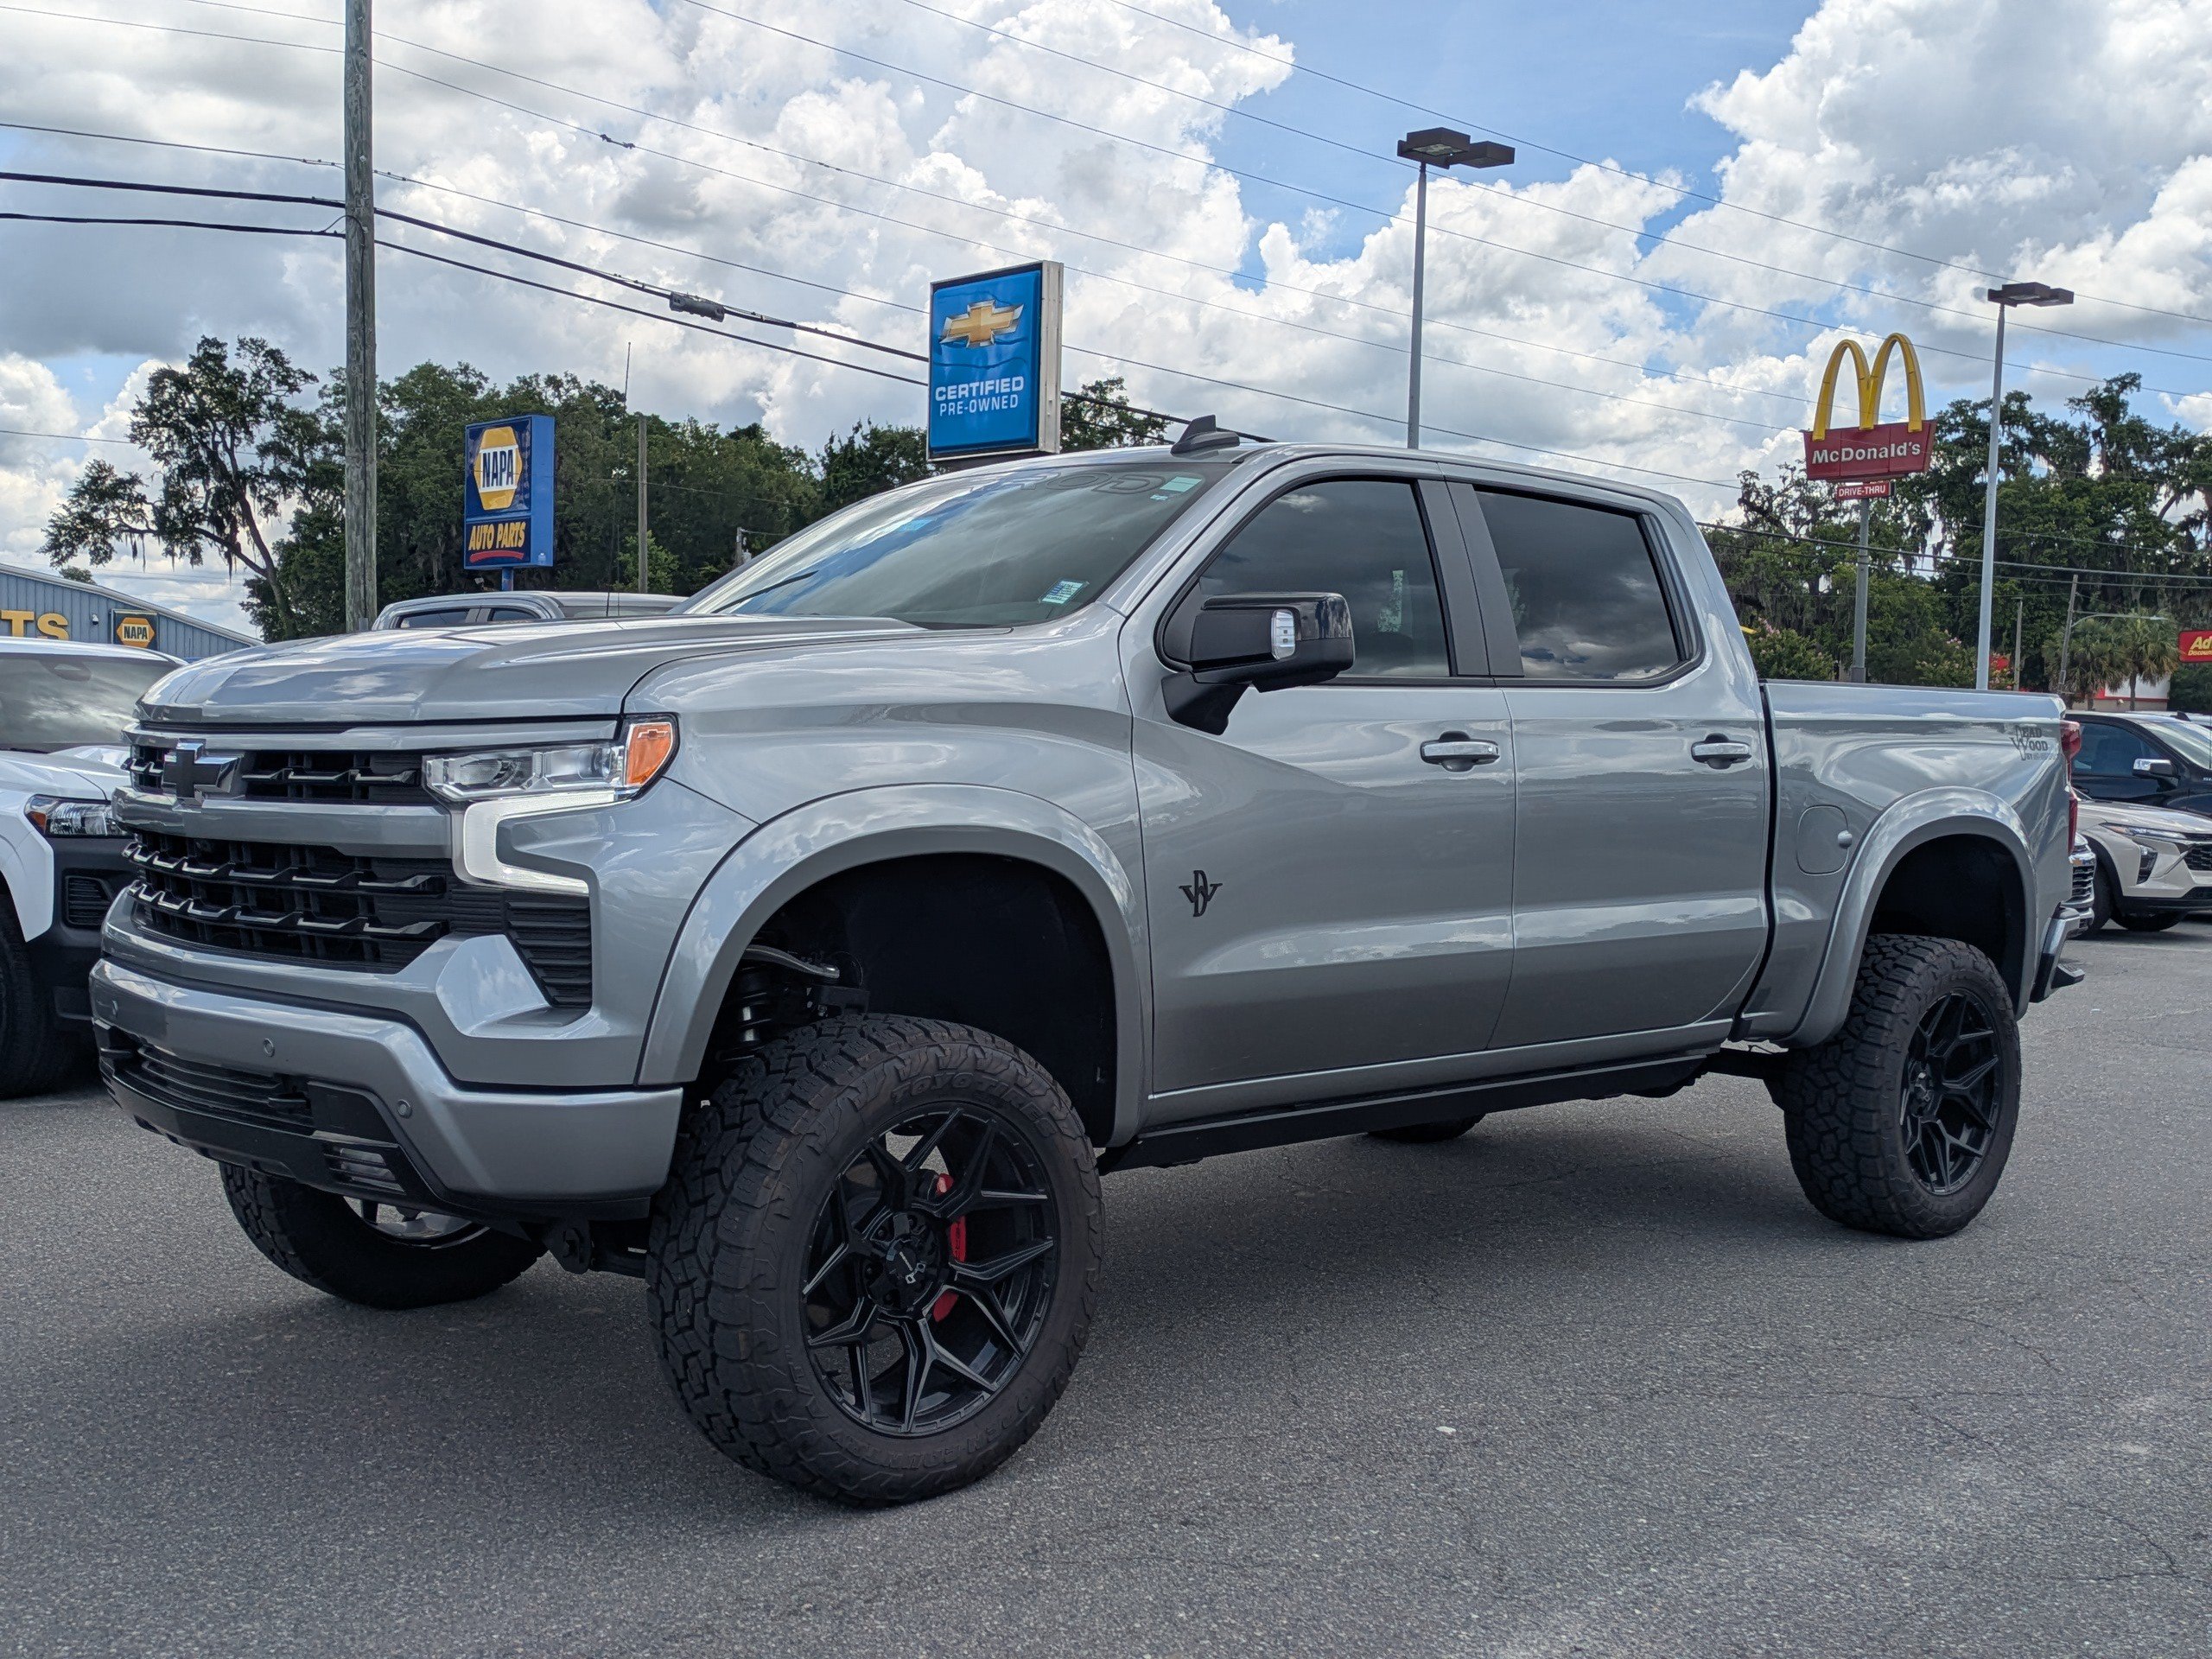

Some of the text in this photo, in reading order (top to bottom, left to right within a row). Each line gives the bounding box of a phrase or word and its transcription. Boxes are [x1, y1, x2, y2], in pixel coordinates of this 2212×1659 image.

[935, 376, 1024, 401] CERTIFIED
[940, 394, 1019, 416] PRE-OWNED
[1812, 442, 1921, 465] McDonald's
[482, 449, 514, 487] NAPA
[1839, 485, 1885, 497] DRIVE-THRU
[468, 522, 526, 550] AUTO PARTS
[124, 626, 148, 639] NAPA
